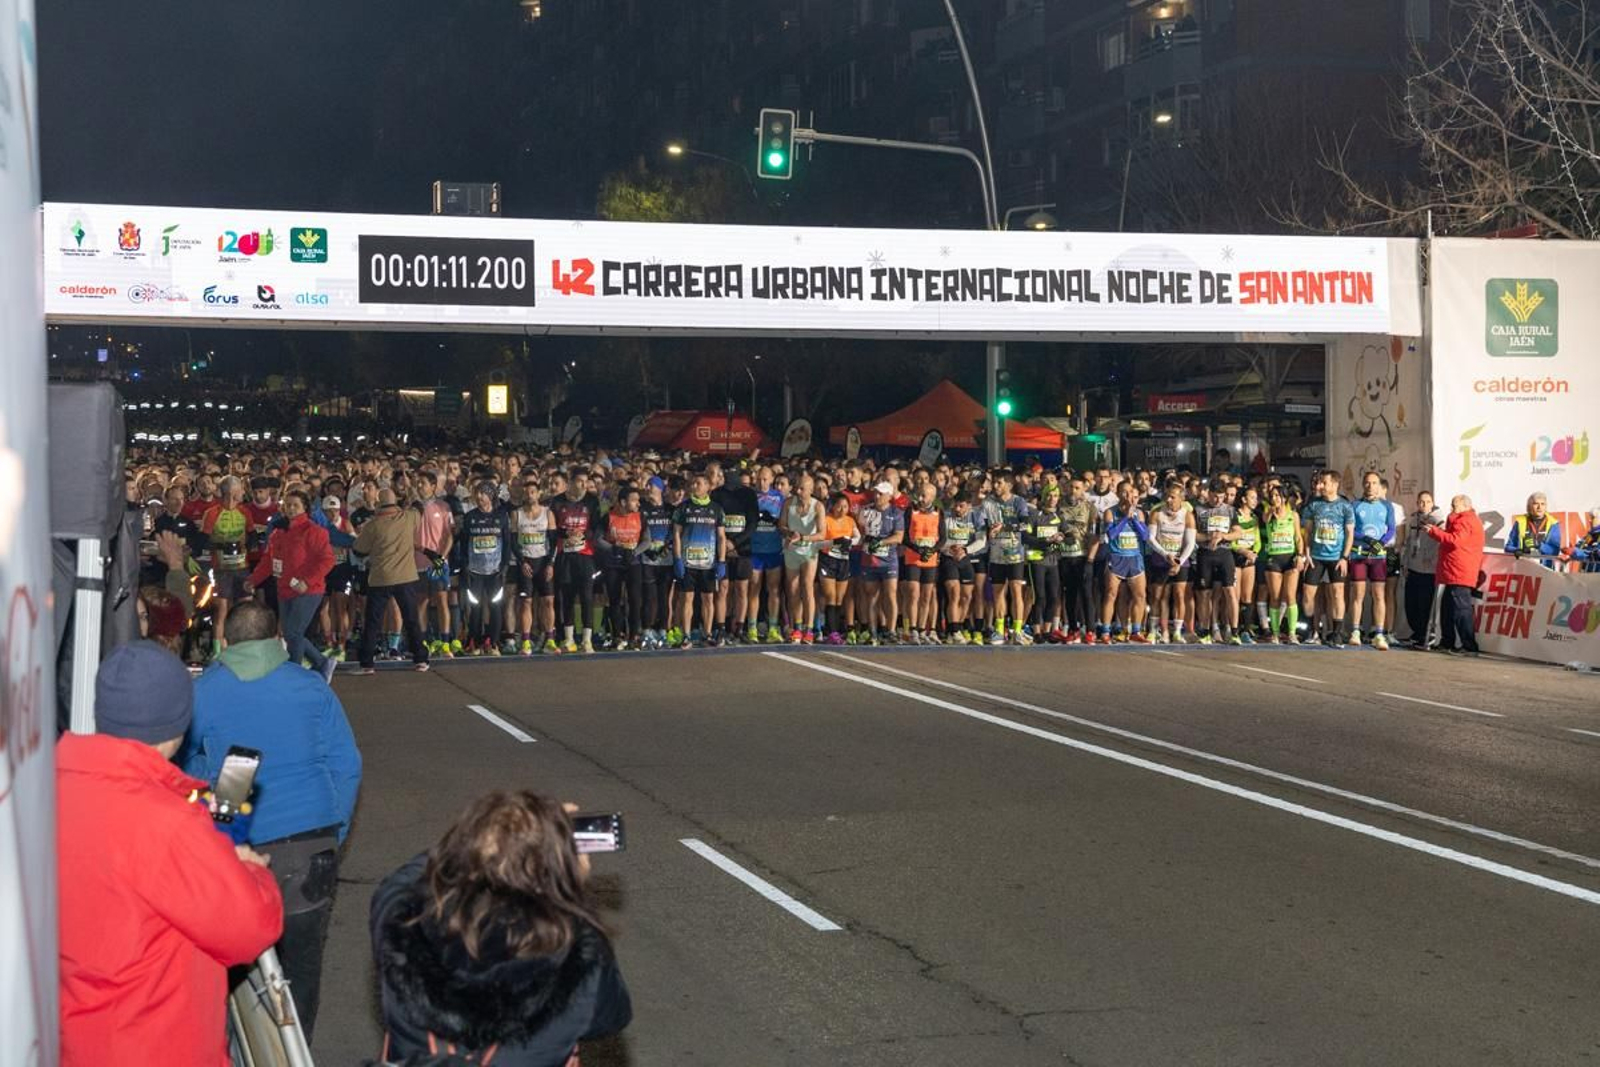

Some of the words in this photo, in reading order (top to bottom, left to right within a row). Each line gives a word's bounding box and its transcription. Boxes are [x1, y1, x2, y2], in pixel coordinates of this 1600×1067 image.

[371, 254, 526, 290] 00:01:11.200
[552, 258, 596, 296] 42
[603, 261, 743, 299] CARRERA
[752, 266, 863, 300] URBANA
[871, 268, 1101, 303] INTERNACIONAL
[1108, 271, 1192, 304] NOCHE
[1200, 271, 1232, 304] DE
[1239, 271, 1289, 306] SAN
[59, 284, 117, 295] calderón
[295, 292, 329, 304] alsa
[1491, 325, 1516, 336] CAJA
[1518, 325, 1553, 336] RURAL
[1473, 376, 1569, 393] calderón
[1157, 400, 1198, 411] Acceso
[1486, 573, 1542, 606] SAN
